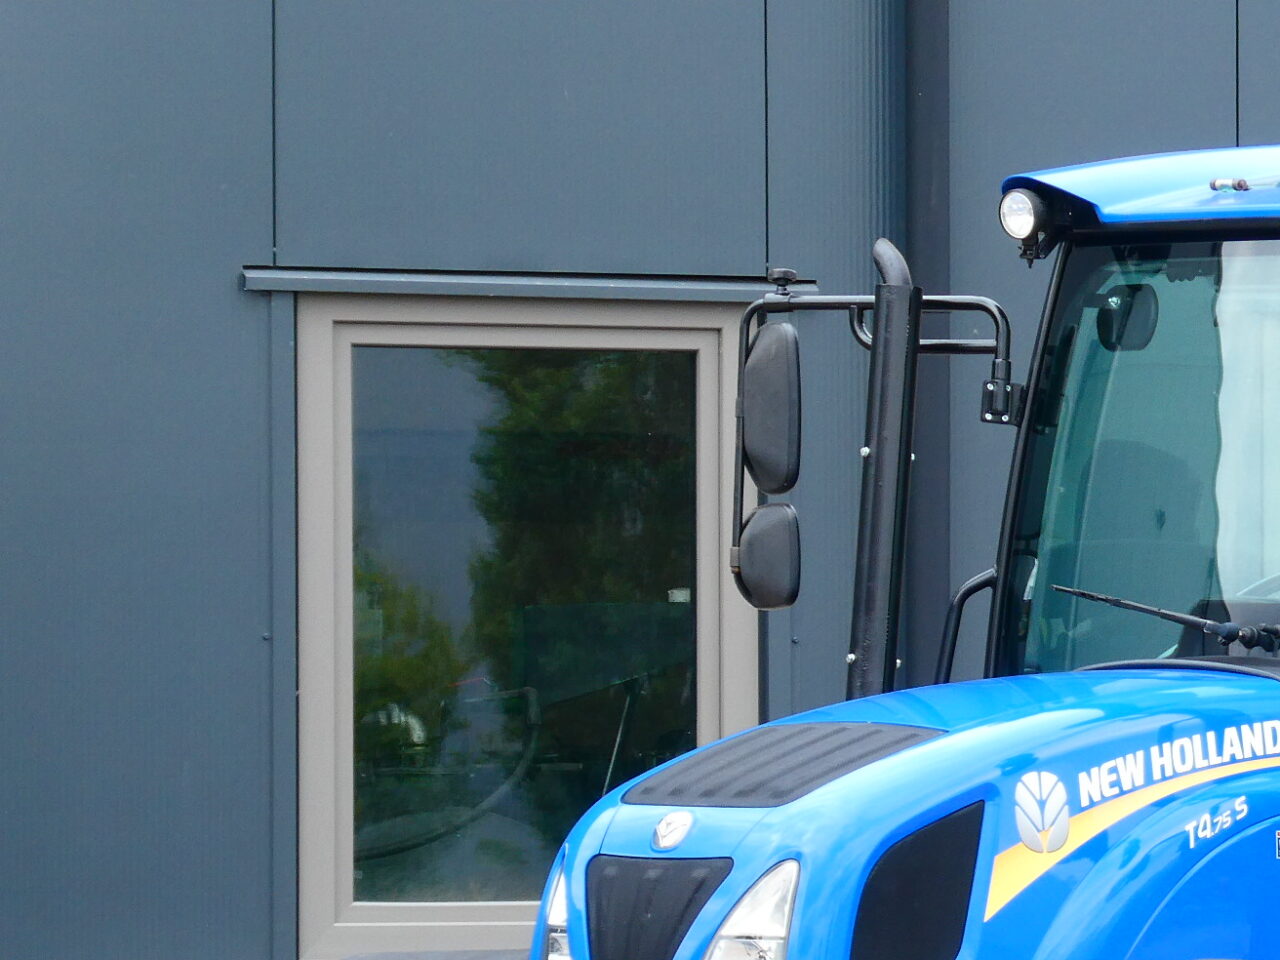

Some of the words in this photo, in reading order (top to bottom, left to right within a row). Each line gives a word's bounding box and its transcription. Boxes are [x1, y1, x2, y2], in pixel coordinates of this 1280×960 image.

[1078, 750, 1145, 808] NEW
[1184, 810, 1232, 849] T4.75
[1235, 795, 1249, 821] S
